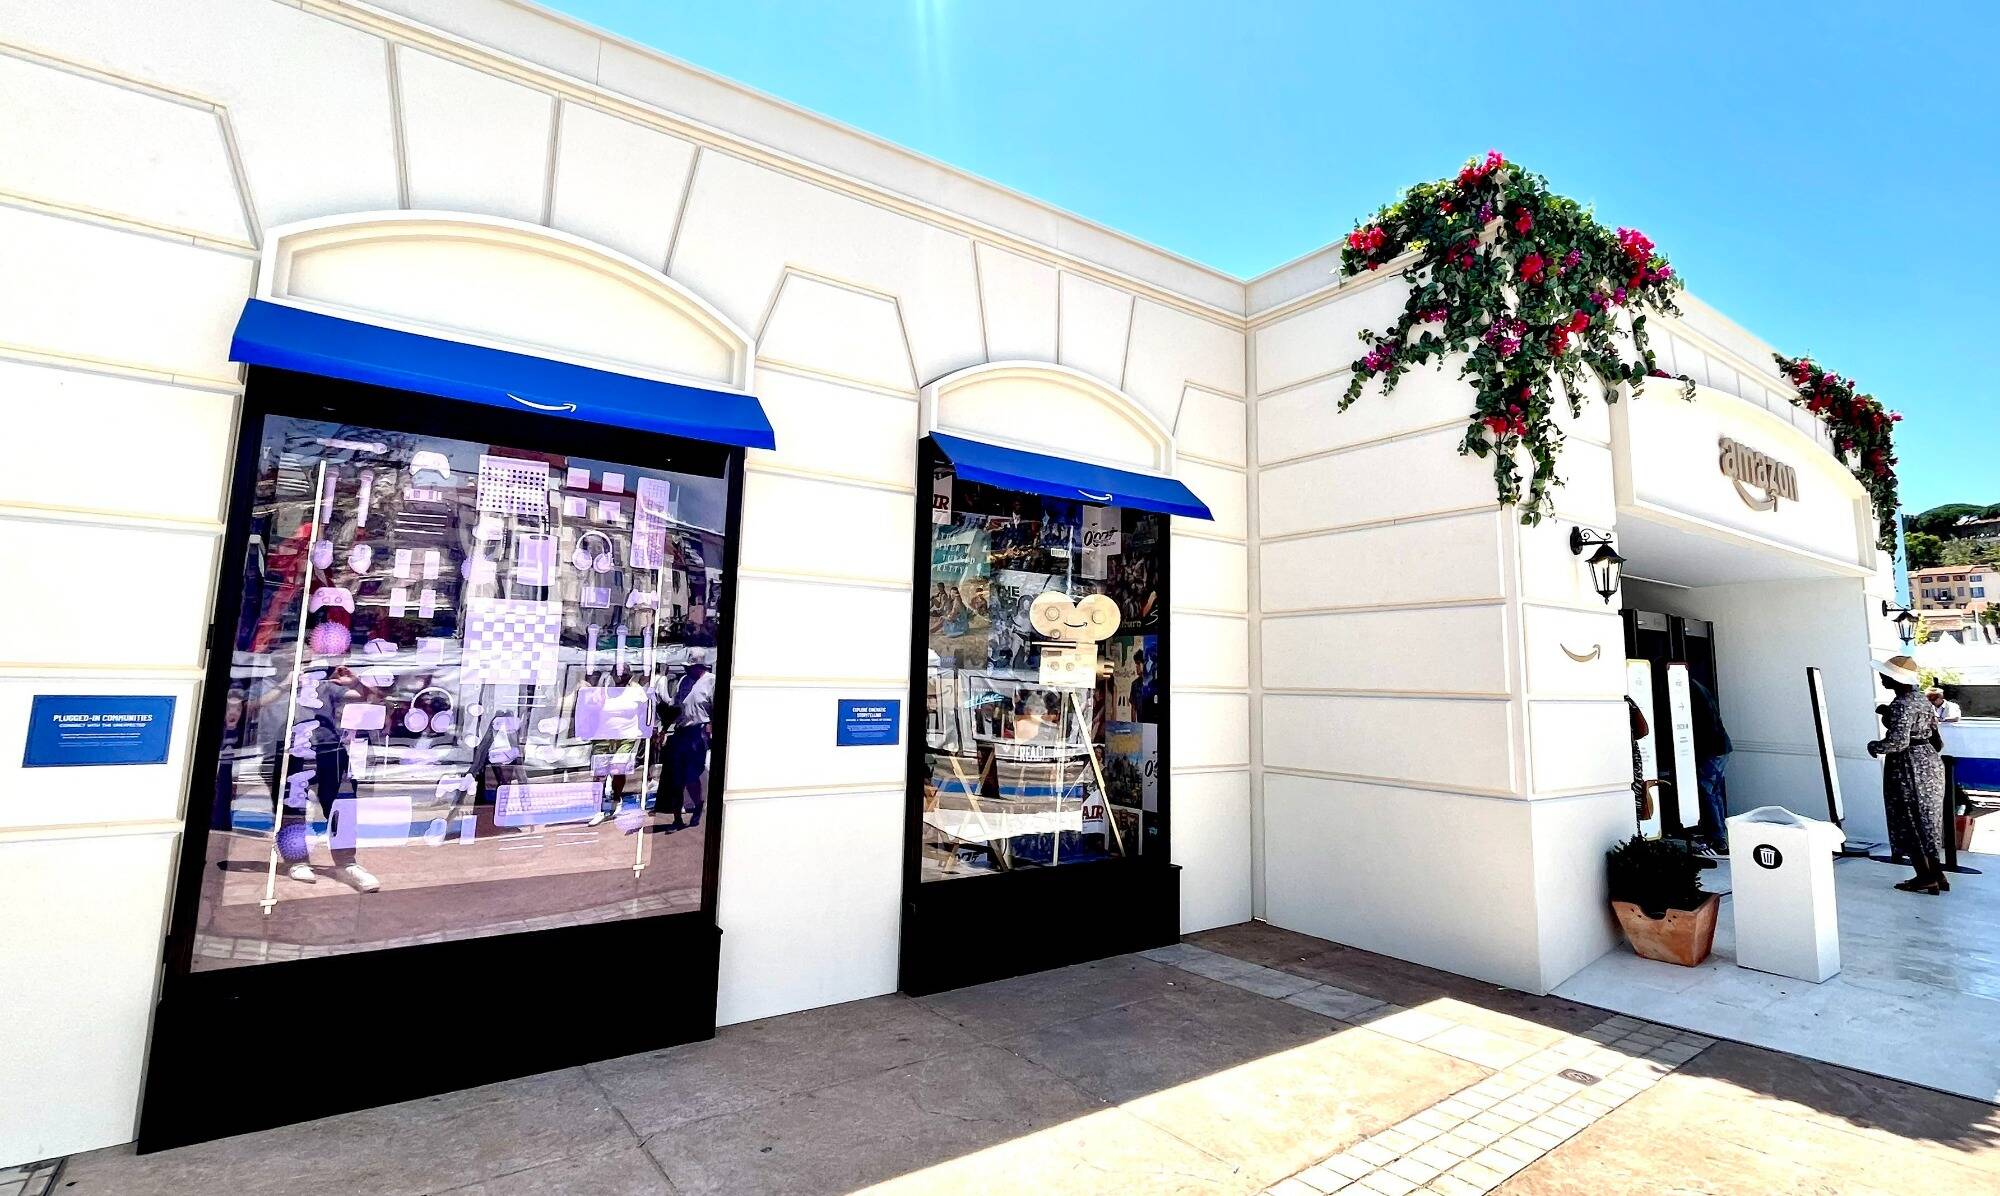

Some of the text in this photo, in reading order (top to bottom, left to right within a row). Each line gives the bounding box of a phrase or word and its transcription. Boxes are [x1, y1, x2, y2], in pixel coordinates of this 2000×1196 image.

[1718, 437, 1799, 502] amazon
[932, 494, 950, 510] IR
[53, 714, 153, 722] PLUGGED-IN COMMUNITIES
[1082, 805, 1104, 820] AIR
